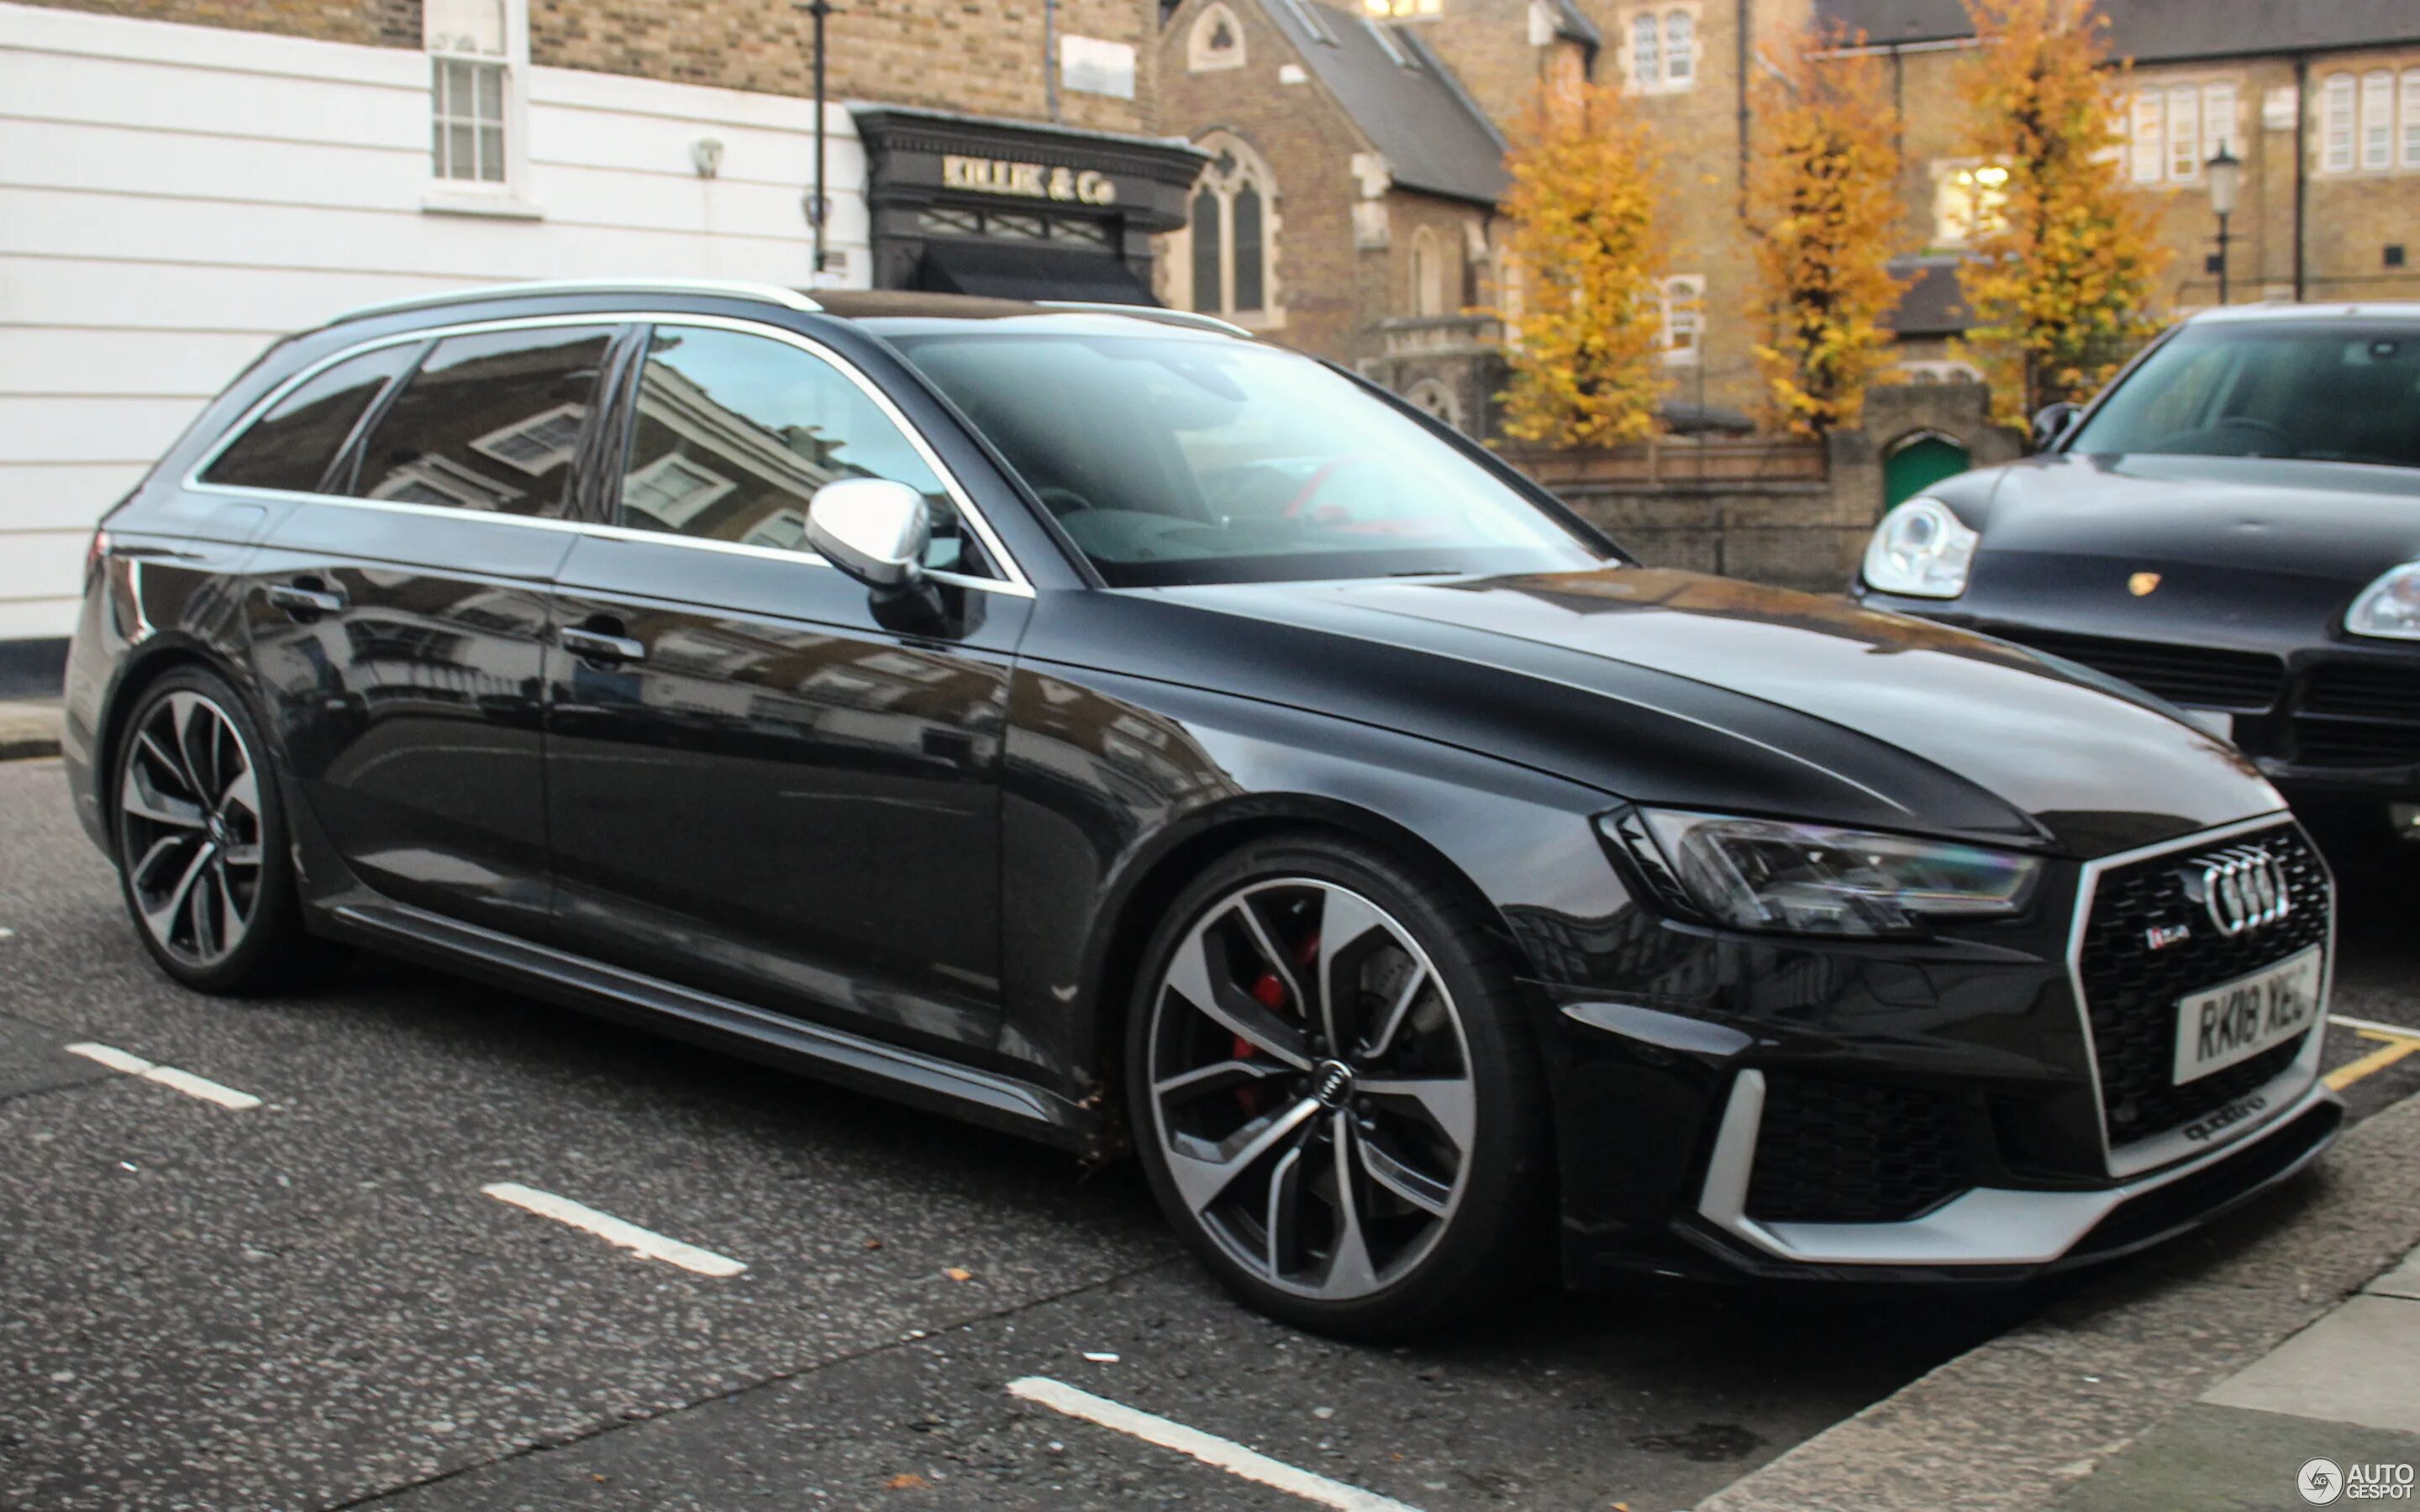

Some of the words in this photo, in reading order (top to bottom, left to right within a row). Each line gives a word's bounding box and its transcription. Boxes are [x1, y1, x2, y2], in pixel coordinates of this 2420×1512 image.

[943, 155, 1047, 198] KILLIK
[1049, 166, 1076, 201] &
[1076, 171, 1116, 205] Co
